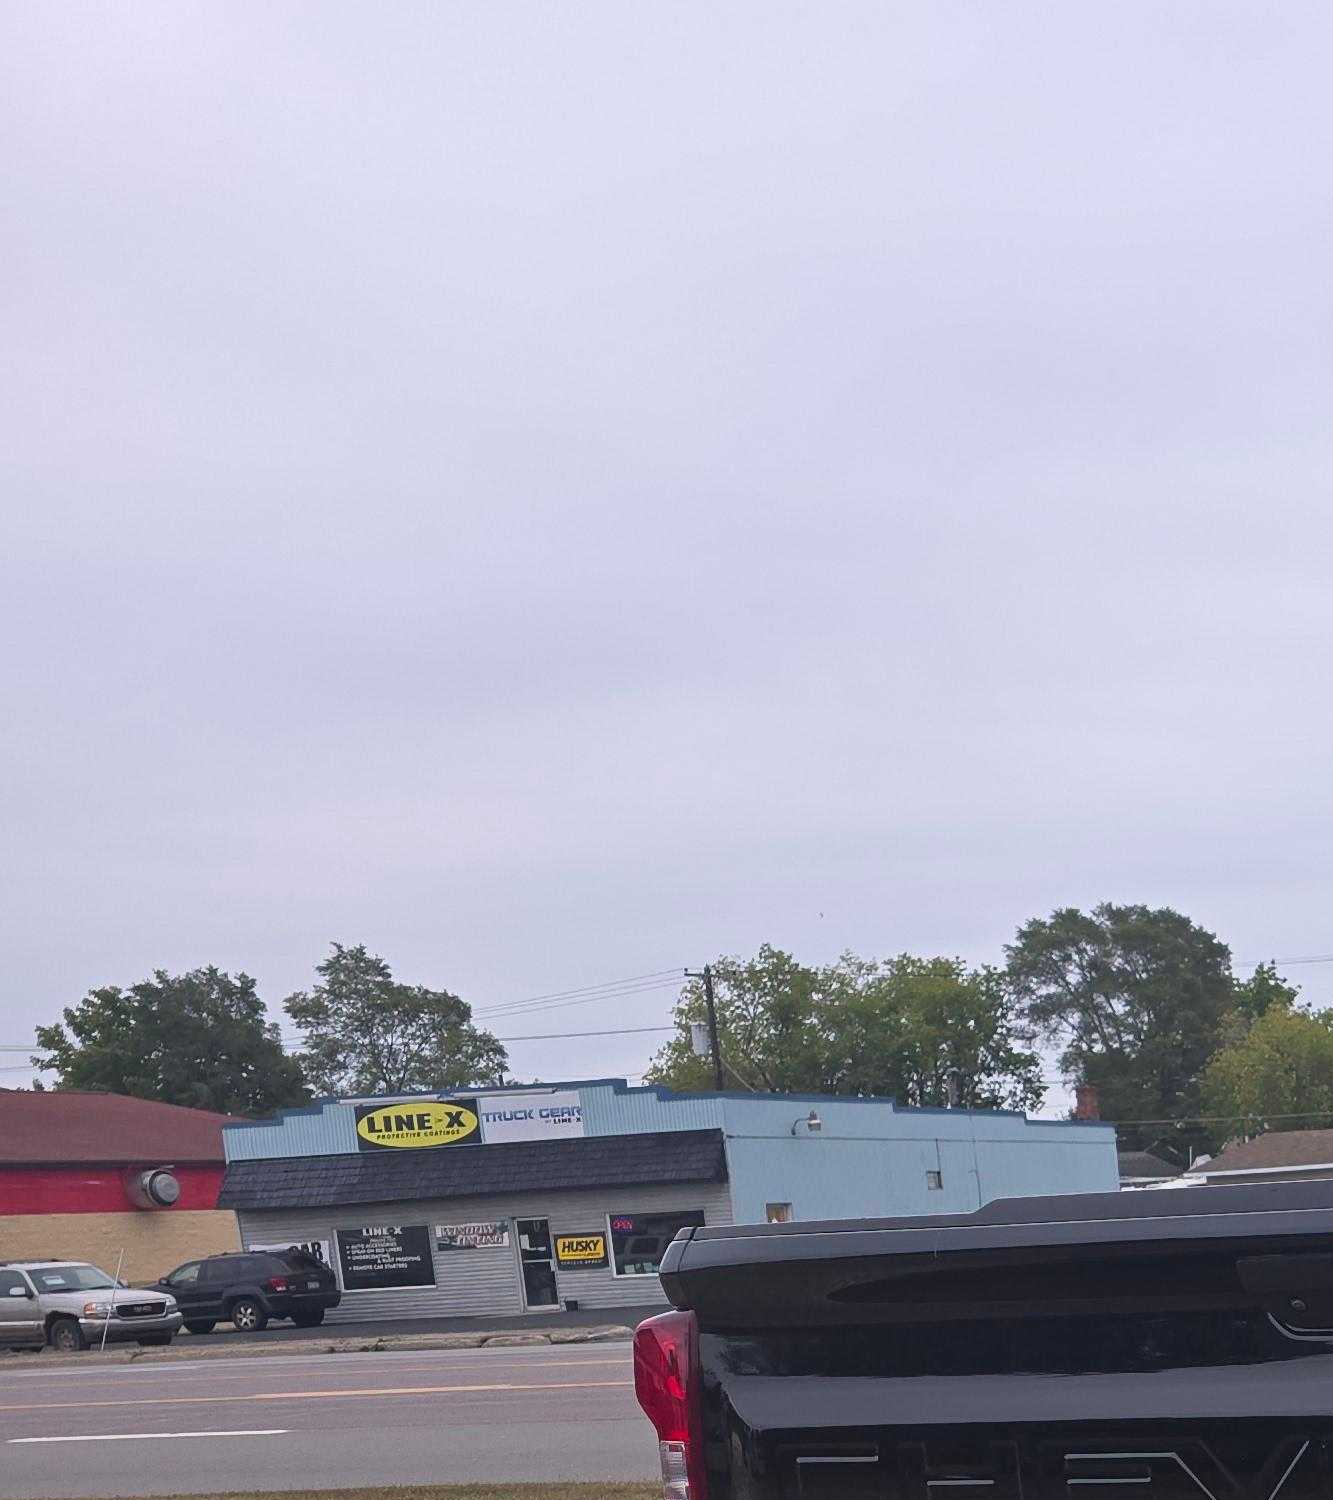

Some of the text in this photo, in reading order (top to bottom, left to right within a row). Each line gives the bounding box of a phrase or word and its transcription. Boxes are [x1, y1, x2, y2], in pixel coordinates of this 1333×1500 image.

[482, 1106, 583, 1122] TRUCK GEAR
[376, 1129, 460, 1140] PROTECTIVE COATINGS
[612, 1220, 632, 1230] OPEN
[561, 1239, 600, 1253] HUSKY
